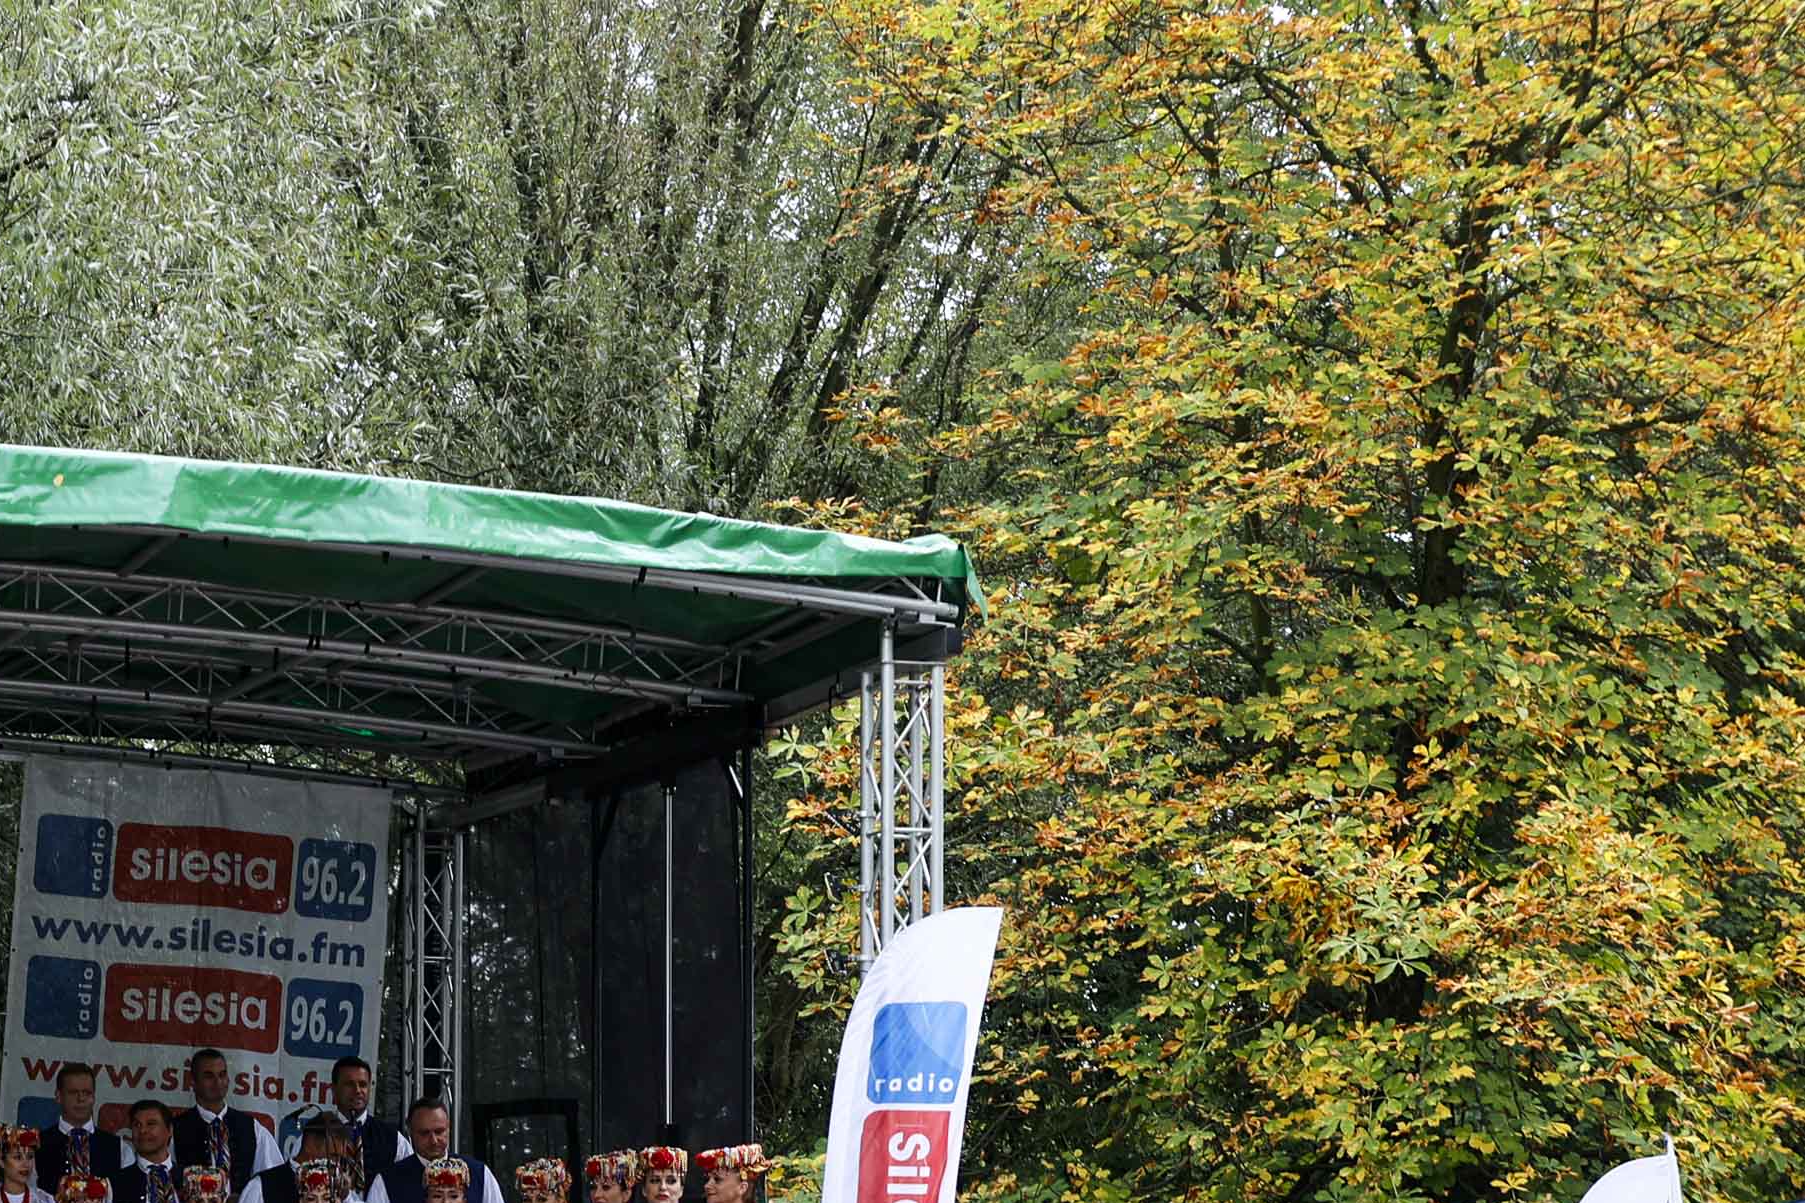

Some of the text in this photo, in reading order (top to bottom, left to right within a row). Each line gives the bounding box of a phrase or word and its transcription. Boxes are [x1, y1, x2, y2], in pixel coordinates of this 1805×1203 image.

[91, 827, 366, 906] radio silesia 96.2
[32, 915, 365, 968] www.silesia.fm
[78, 967, 355, 1046] radio silesia 96.2
[874, 1072, 954, 1094] radio
